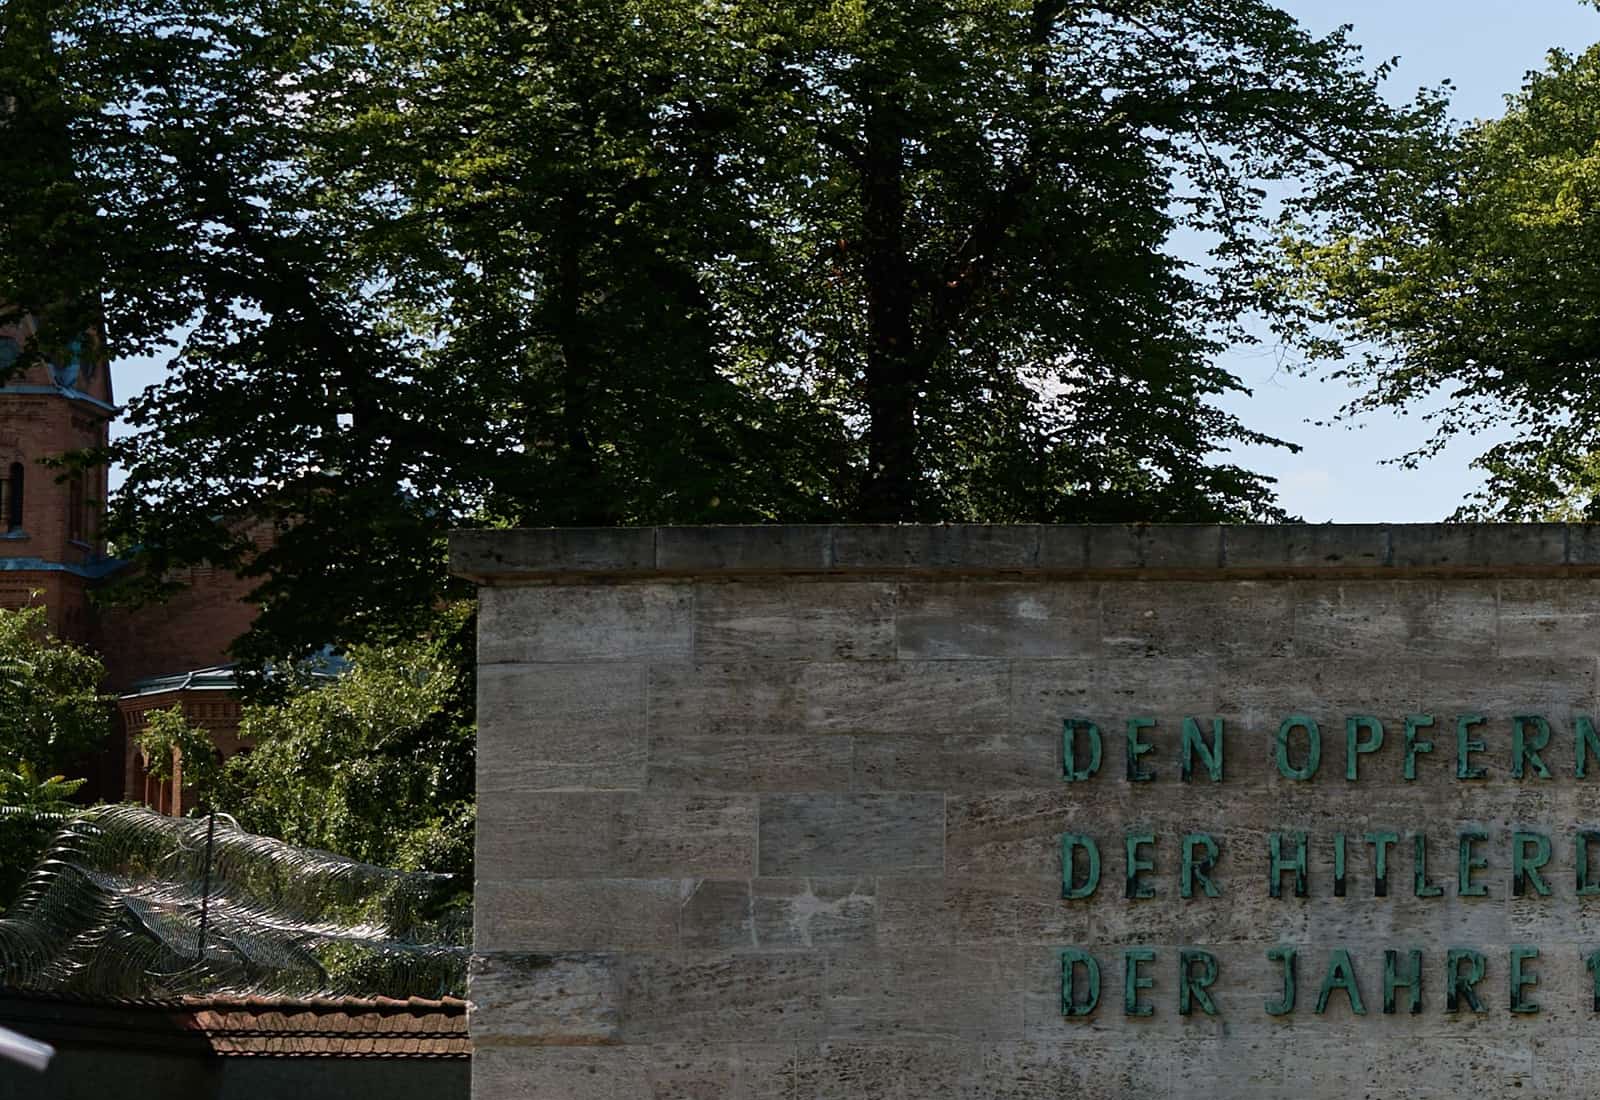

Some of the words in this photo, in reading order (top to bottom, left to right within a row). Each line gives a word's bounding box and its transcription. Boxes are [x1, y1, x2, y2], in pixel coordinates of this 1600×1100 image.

[1062, 716, 1225, 783] DEN
[1060, 830, 1221, 900] DER
[1060, 945, 1221, 1017] DER
[1264, 947, 1540, 1016] JAHRE
